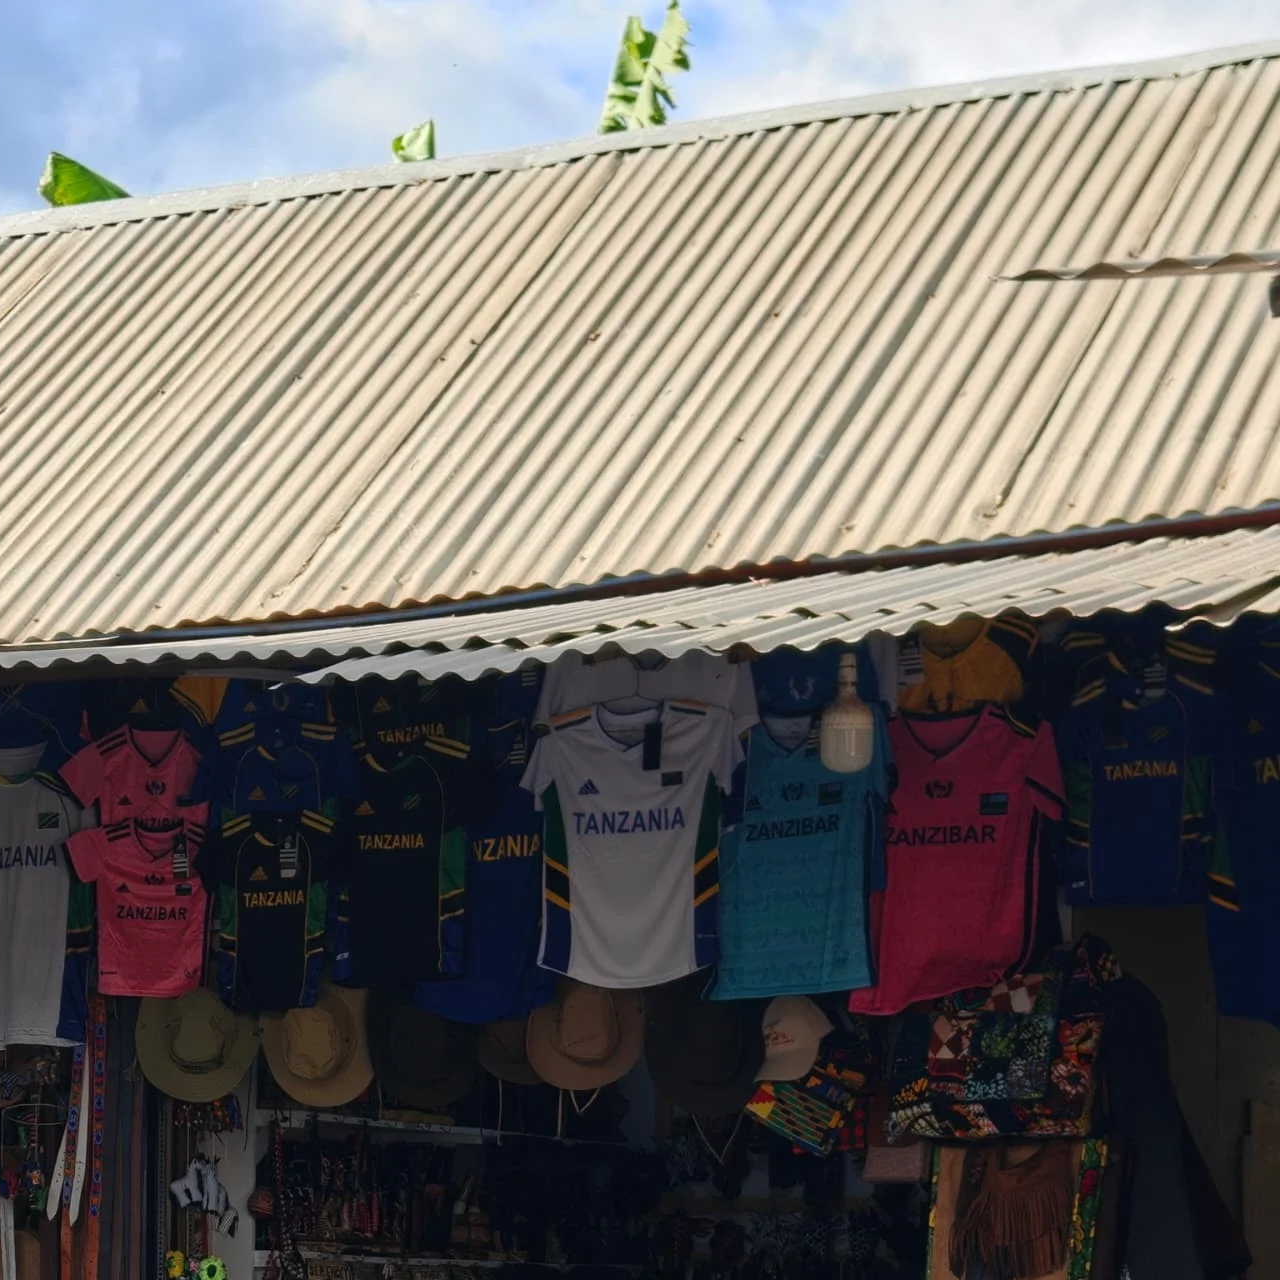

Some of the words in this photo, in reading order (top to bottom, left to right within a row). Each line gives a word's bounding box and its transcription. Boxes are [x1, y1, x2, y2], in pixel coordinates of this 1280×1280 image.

[1104, 760, 1178, 781] TANZANIA
[573, 806, 685, 835] TANZANIA
[745, 813, 840, 842] ZANZIBAR
[357, 833, 424, 850] TANZANIA
[885, 824, 996, 846] ZANZIBAR
[242, 889, 305, 909] TANZANIA
[117, 904, 187, 921] ZANZIBAR
